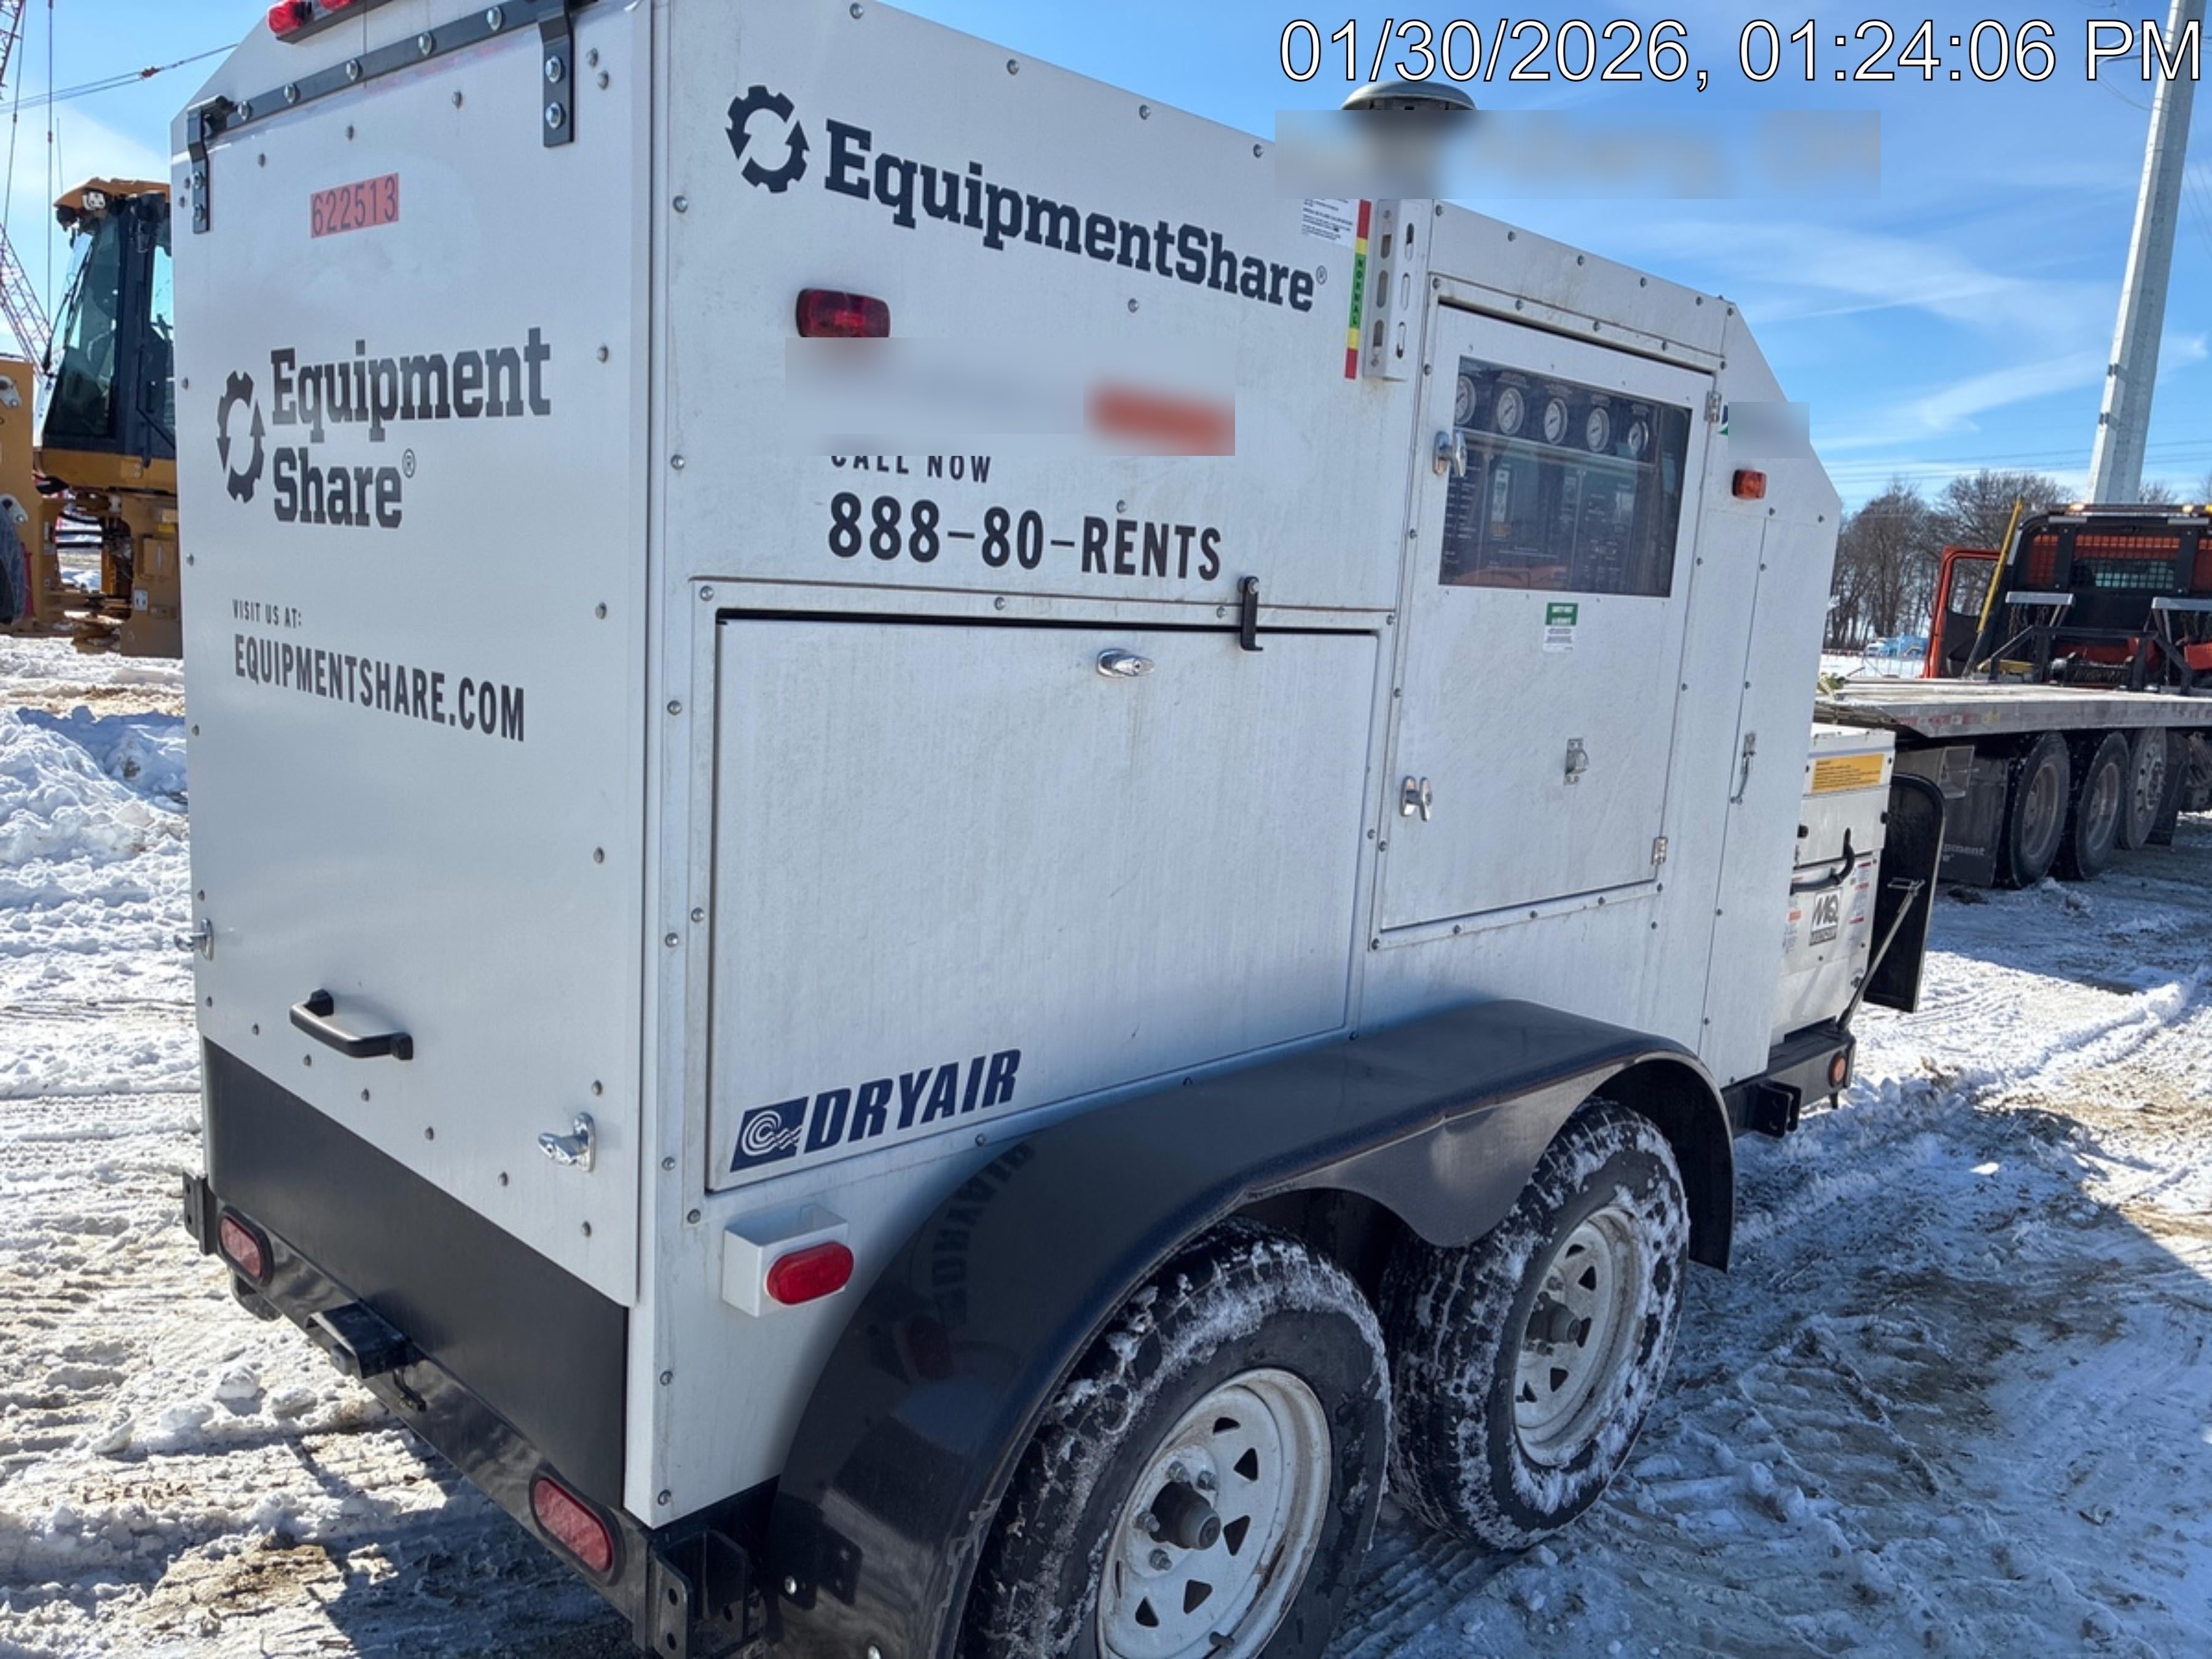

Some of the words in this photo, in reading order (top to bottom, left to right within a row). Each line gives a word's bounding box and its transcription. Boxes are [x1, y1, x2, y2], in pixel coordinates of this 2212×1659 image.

[313, 176, 394, 236] 622513
[270, 326, 551, 443] Equipment
[927, 456, 991, 484] NOW
[828, 492, 1222, 581] 888-80-RENTS
[232, 598, 261, 622] VISIT
[265, 603, 279, 626] US
[283, 606, 302, 629] AT:
[234, 633, 524, 742] EQUIPMENTSHARE.COM
[803, 1048, 1021, 1154] DRYAIR
